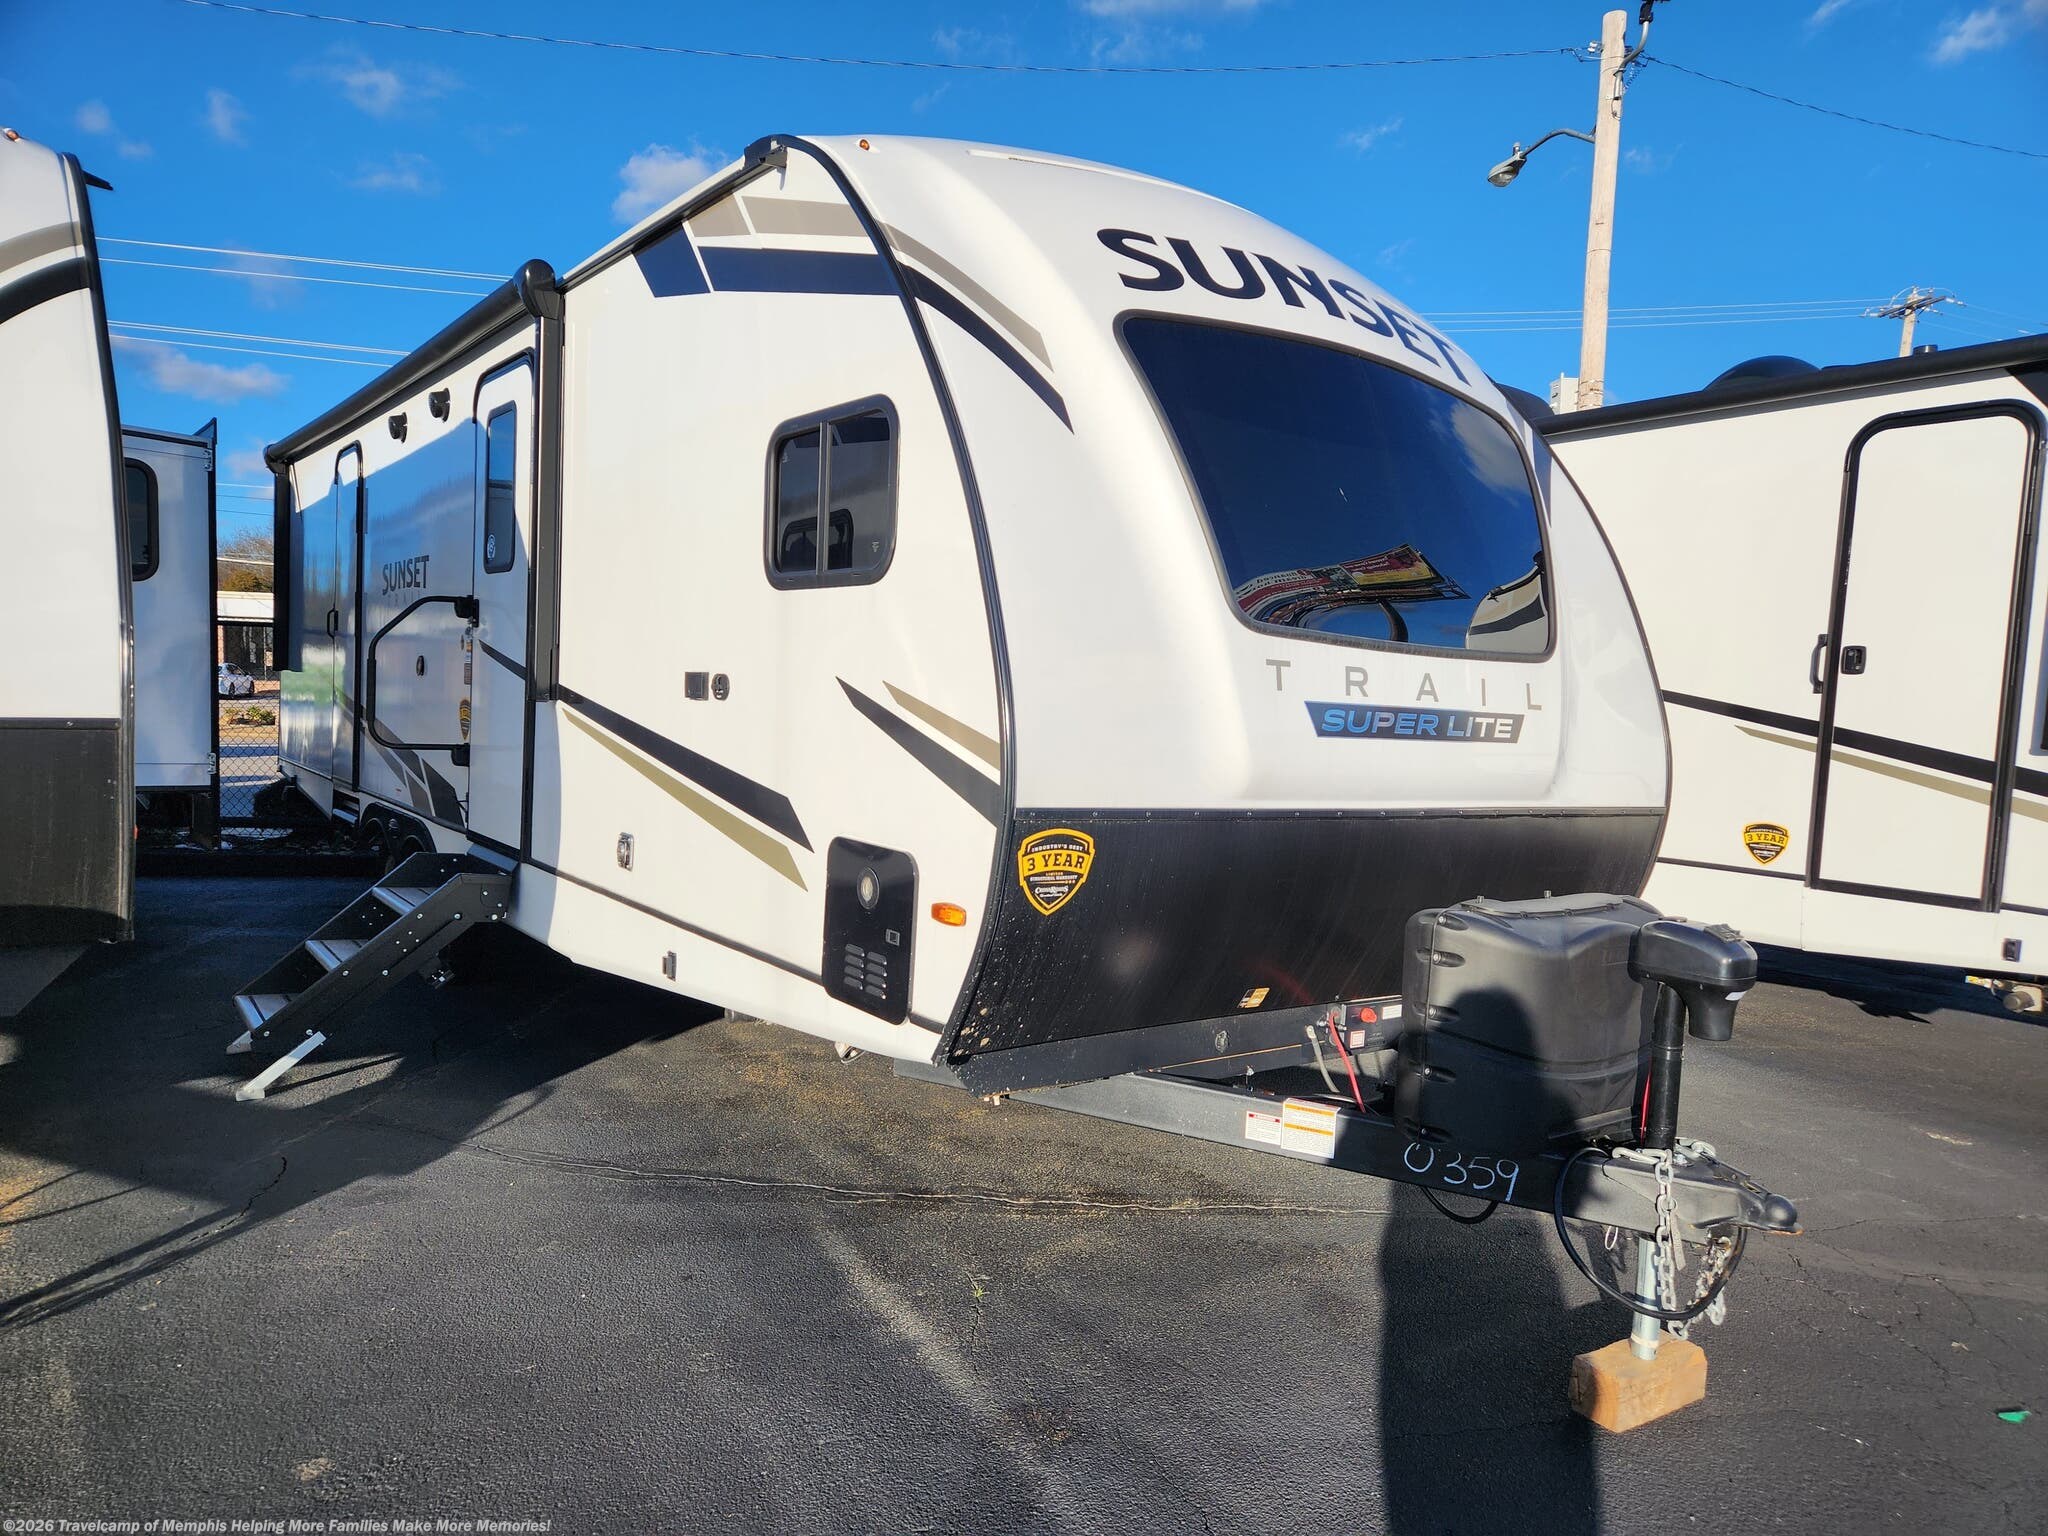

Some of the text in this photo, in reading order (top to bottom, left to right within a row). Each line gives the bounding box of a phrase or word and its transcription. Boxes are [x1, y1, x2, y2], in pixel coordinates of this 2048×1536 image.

[1097, 228, 1472, 387] SUNSET
[382, 555, 430, 596] SUNSET
[1265, 659, 1542, 711] TRAIL
[1321, 708, 1514, 739] SUPER LITE
[1756, 834, 1784, 845] YEAR
[1027, 853, 1085, 871] 3 YEAR
